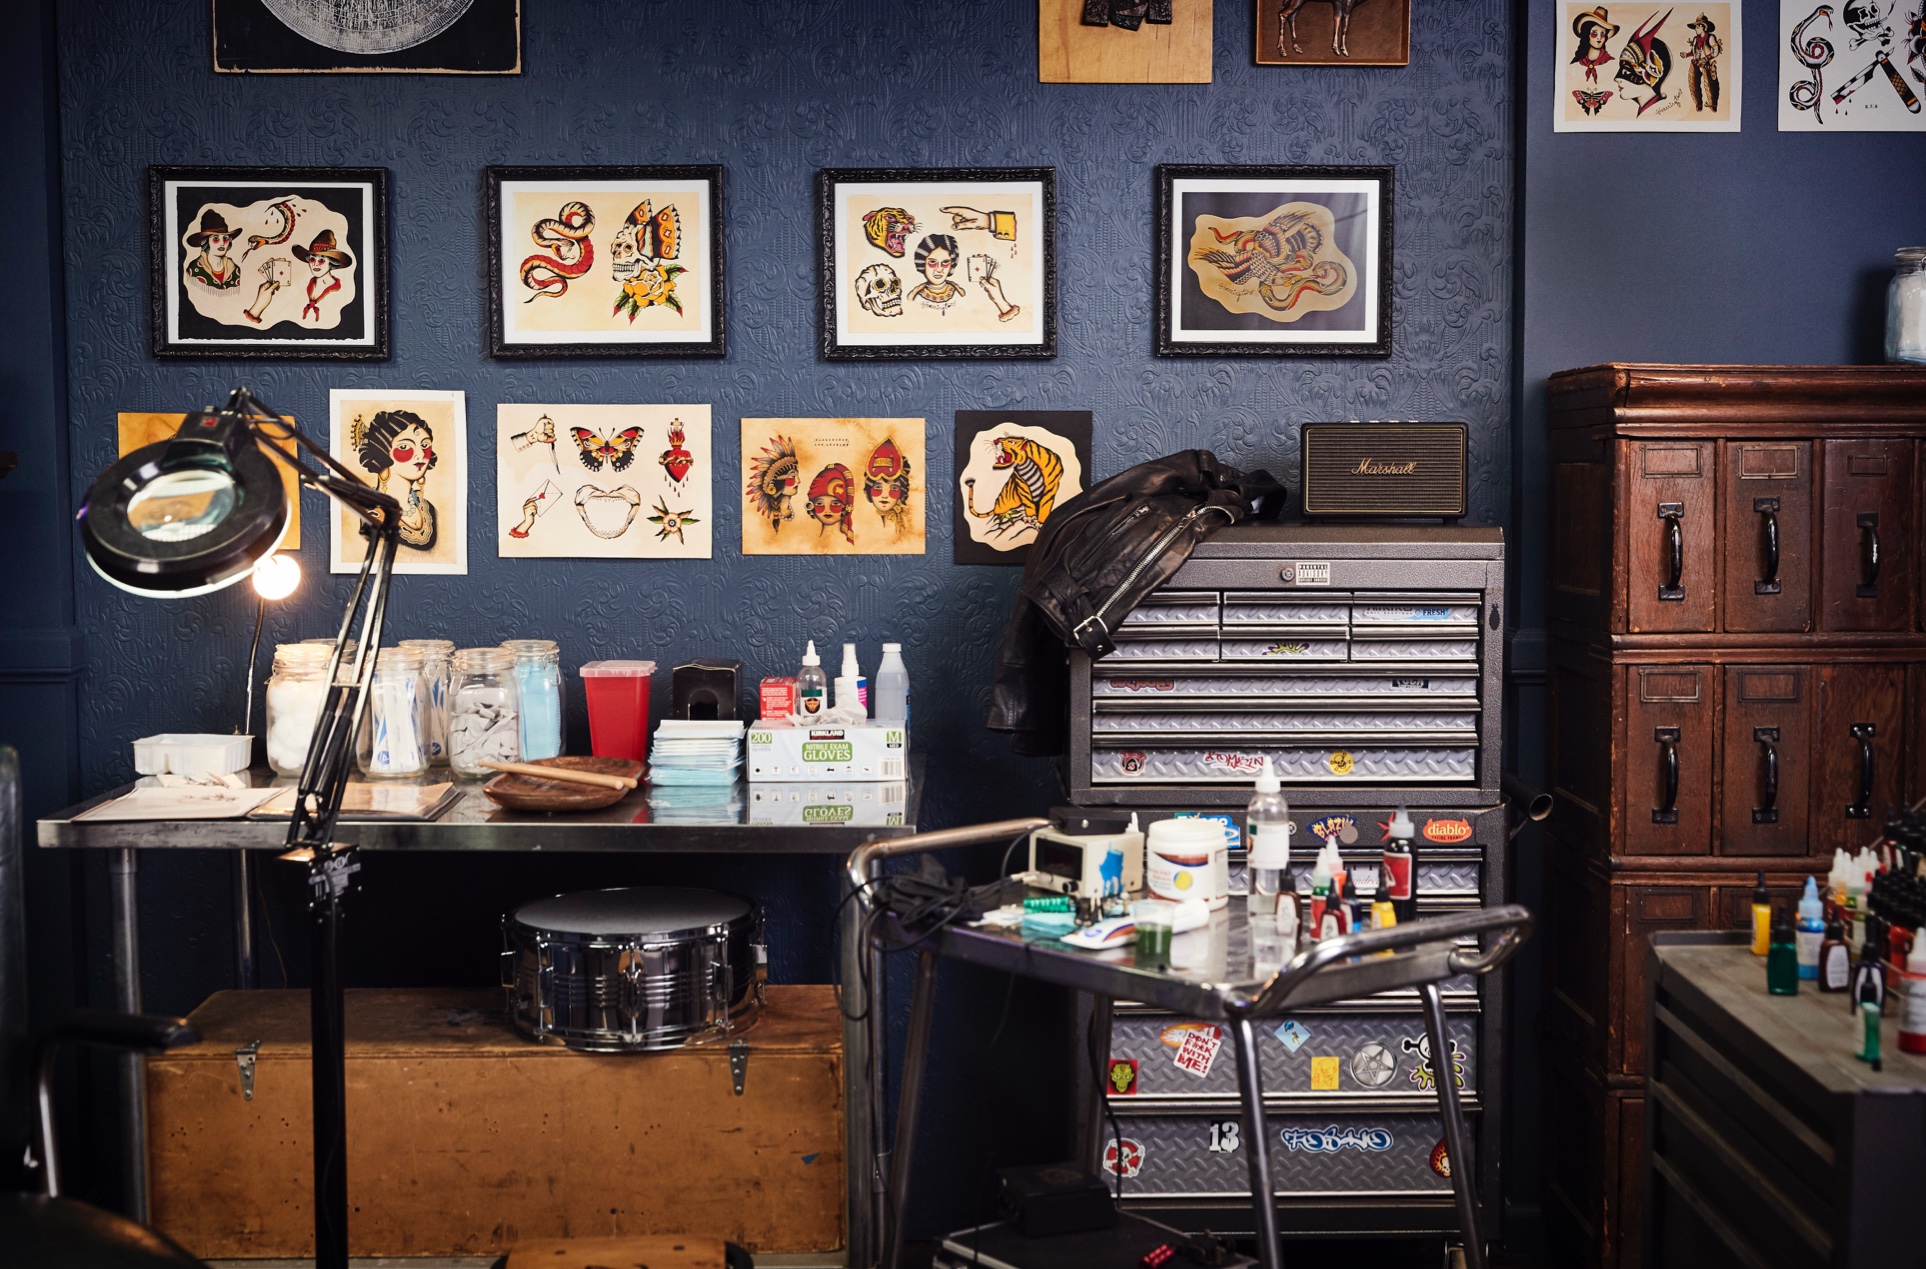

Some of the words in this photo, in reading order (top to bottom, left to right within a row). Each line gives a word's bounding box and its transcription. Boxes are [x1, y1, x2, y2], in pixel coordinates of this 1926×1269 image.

[1351, 458, 1417, 474] Marshall
[1422, 608, 1446, 616] FRESH
[751, 733, 771, 743] 200
[888, 732, 900, 743] M
[804, 750, 851, 761] GLOVES
[1427, 823, 1469, 836] diablo
[1182, 1046, 1210, 1064] WITH
[1209, 1121, 1239, 1152] 13
